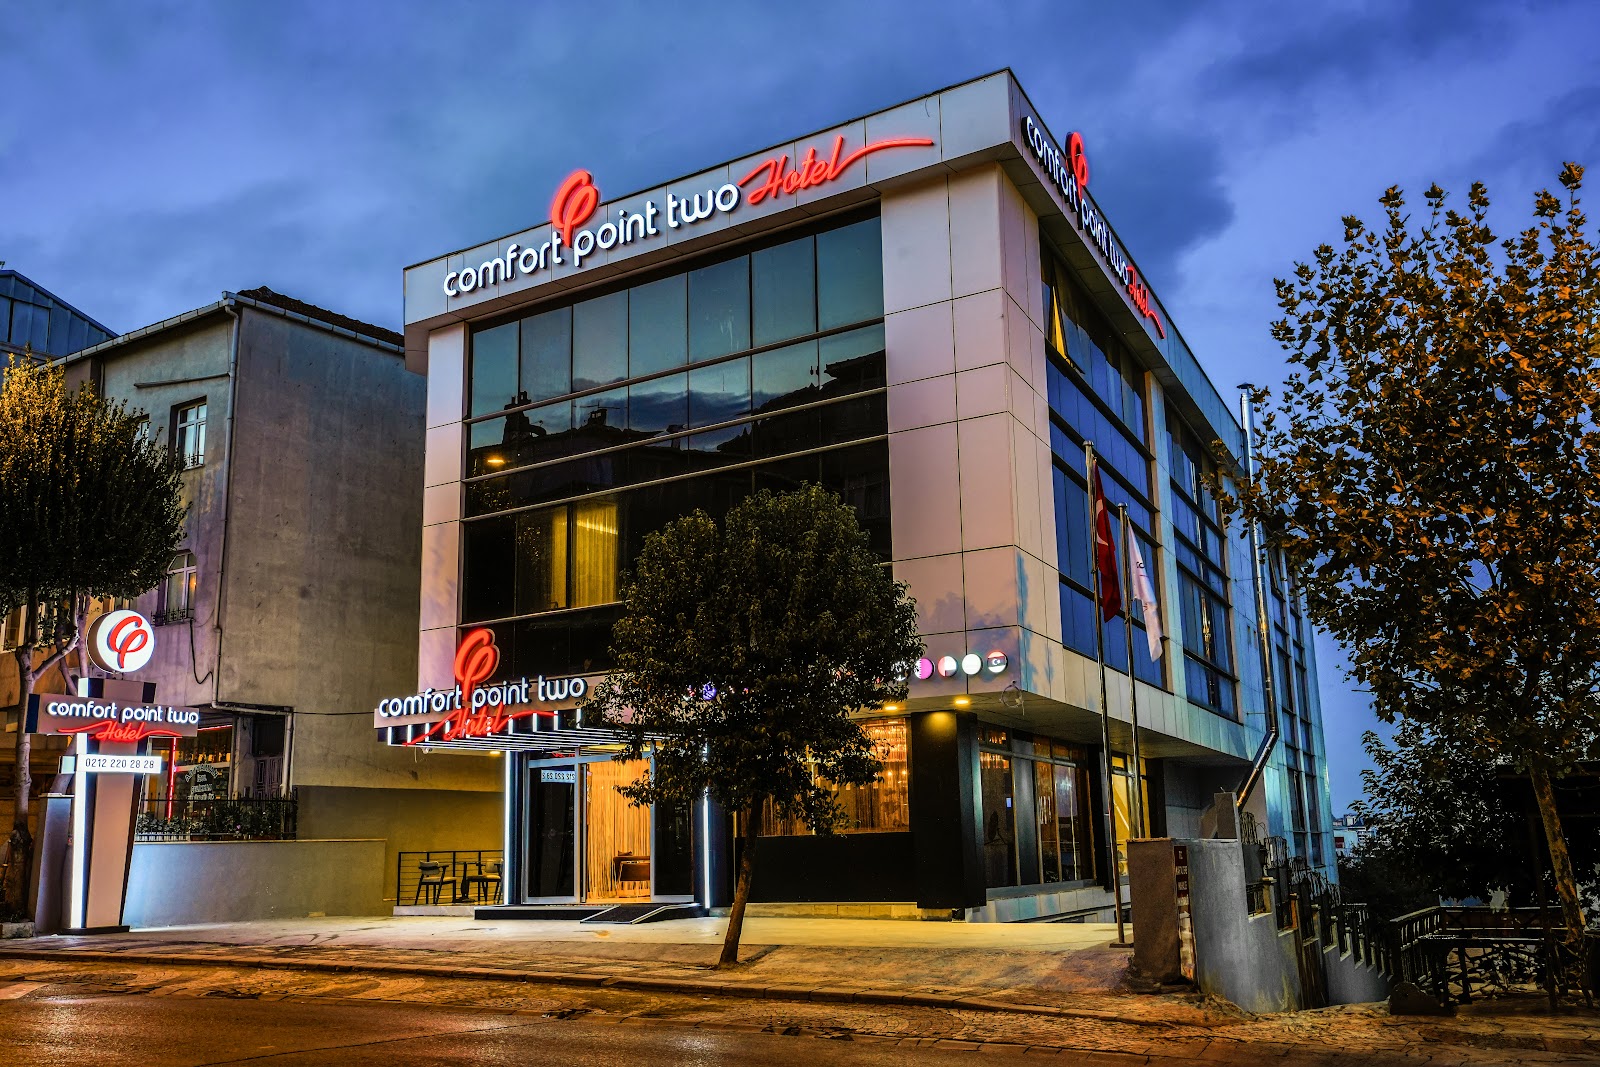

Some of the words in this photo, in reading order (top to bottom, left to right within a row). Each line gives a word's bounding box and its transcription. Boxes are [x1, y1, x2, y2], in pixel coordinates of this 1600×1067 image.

[443, 236, 563, 297] comfort
[574, 201, 658, 267] point
[667, 183, 741, 224] two
[738, 135, 934, 206] Hotel
[1024, 115, 1078, 212] comfort
[1080, 198, 1108, 256] point
[1108, 235, 1128, 285] two
[47, 701, 116, 718] comfort
[121, 706, 162, 723] point
[167, 707, 199, 724] two
[378, 685, 462, 717] comfort
[471, 676, 529, 713] point
[537, 675, 585, 701] two
[85, 757, 107, 768] 0212
[110, 758, 127, 769] 220
[130, 759, 141, 769] 28
[143, 760, 155, 769] 28
